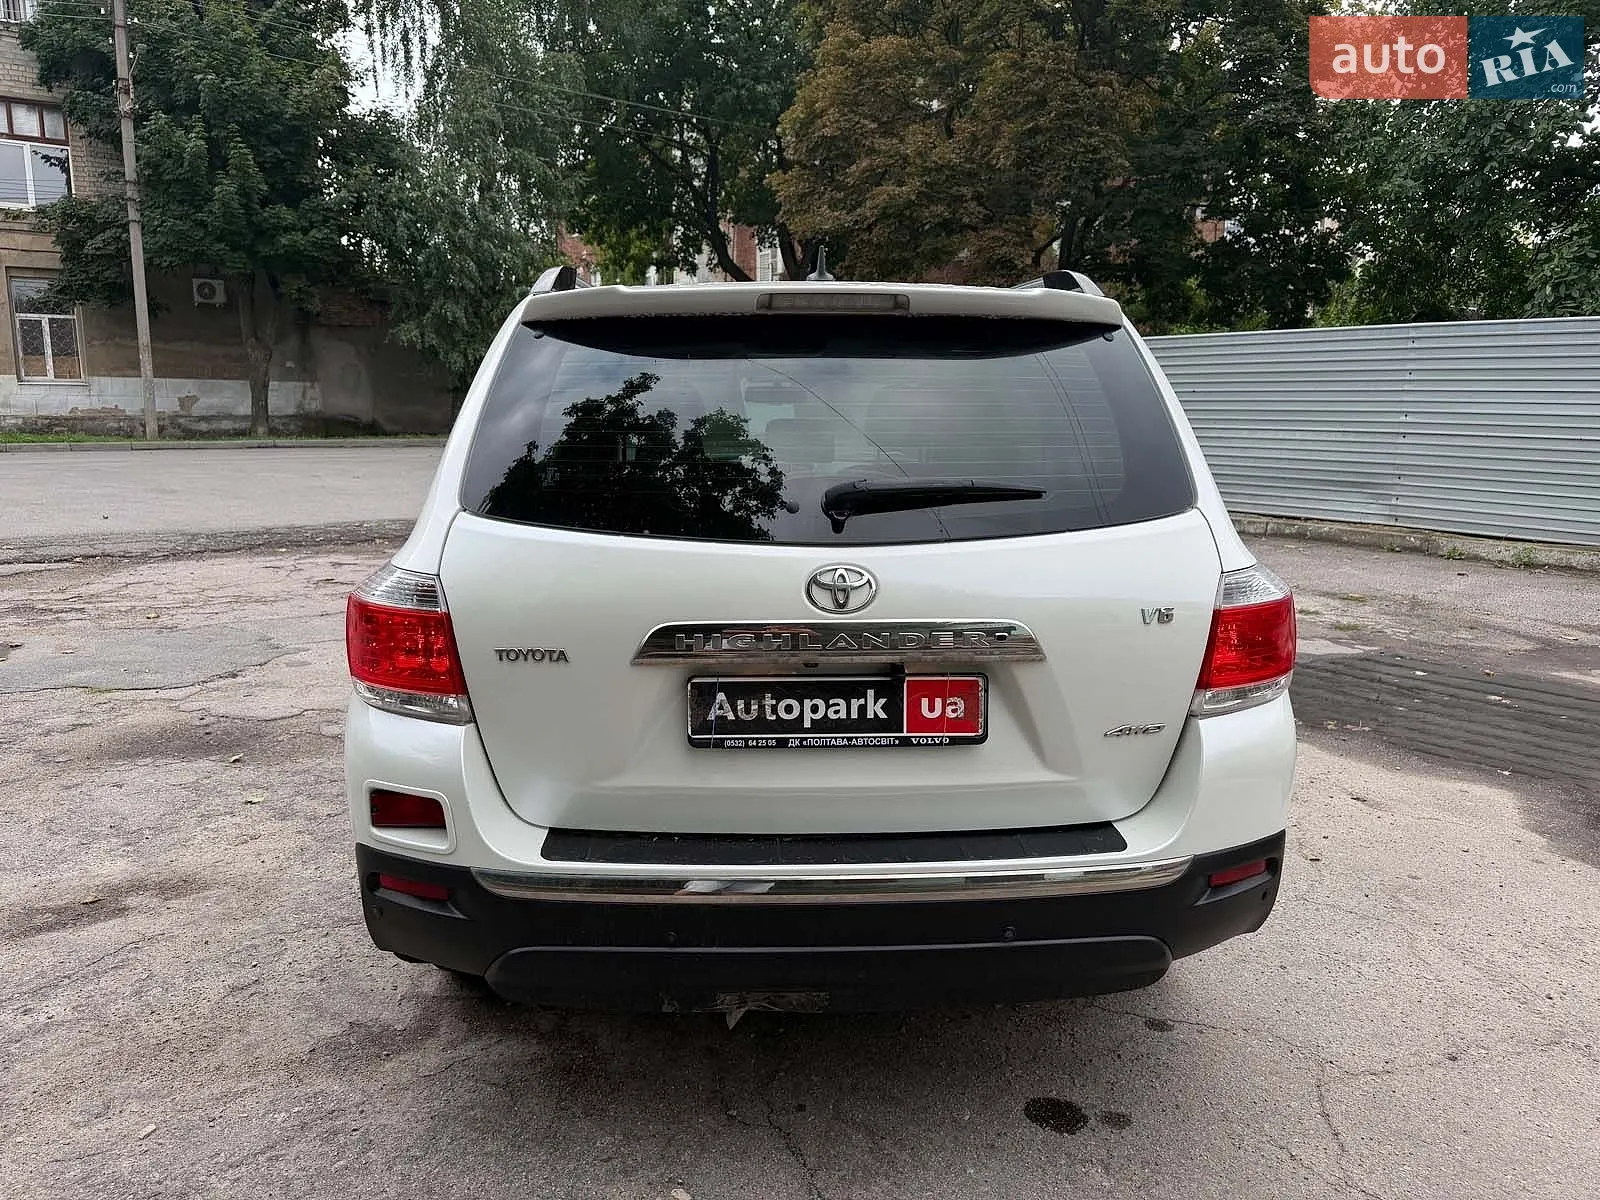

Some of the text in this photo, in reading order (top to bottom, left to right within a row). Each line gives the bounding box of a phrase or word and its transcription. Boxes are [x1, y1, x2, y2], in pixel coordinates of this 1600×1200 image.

[1141, 606, 1175, 625] V6
[675, 631, 991, 651] HIGHLANDER
[493, 647, 569, 663] TOYOTA
[706, 689, 965, 728] Autopark ua
[724, 737, 899, 748] (0532) 64 25 05 ДК «ПОЛТАВА-АВТОСВІТ»
[910, 737, 950, 745] VOLVO
